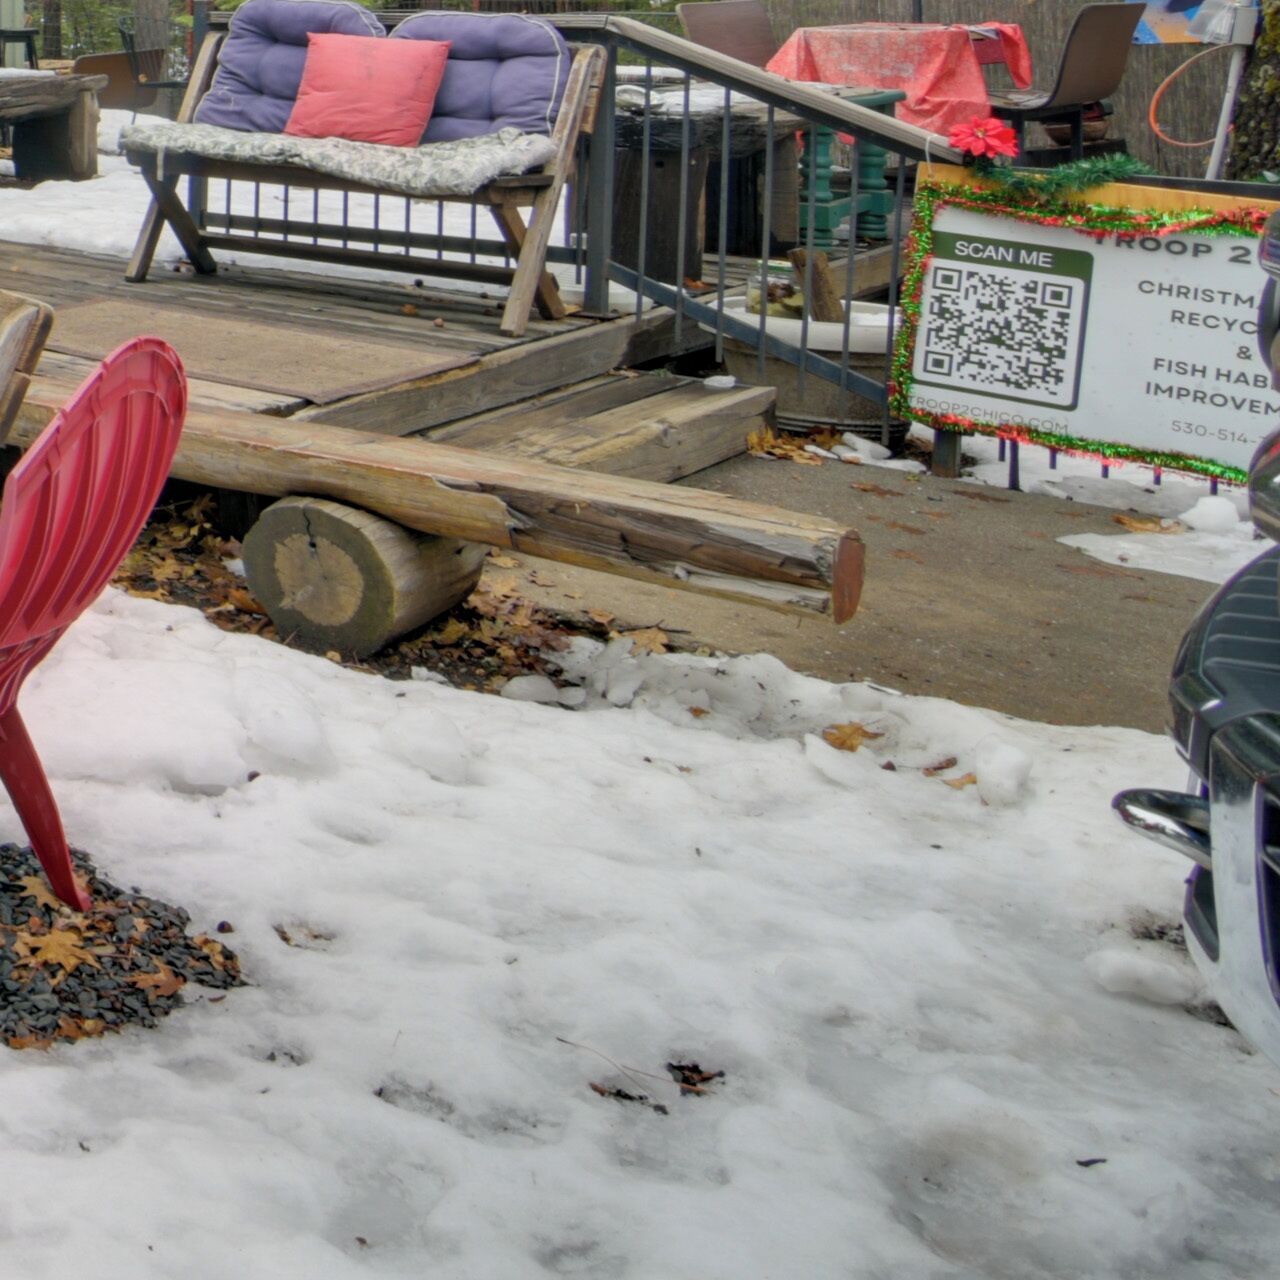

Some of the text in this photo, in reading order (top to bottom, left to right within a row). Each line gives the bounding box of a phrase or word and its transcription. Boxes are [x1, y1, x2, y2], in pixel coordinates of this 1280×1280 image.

[954, 240, 1054, 268] SCAN ME
[1138, 280, 1261, 310] CHRISTM
[1170, 309, 1259, 335] RECYC
[1236, 345, 1253, 361] &
[1153, 357, 1275, 390] FISH HAB
[908, 395, 1068, 436] TROOP2CHICOCOM
[1171, 420, 1265, 445] 530-514-
